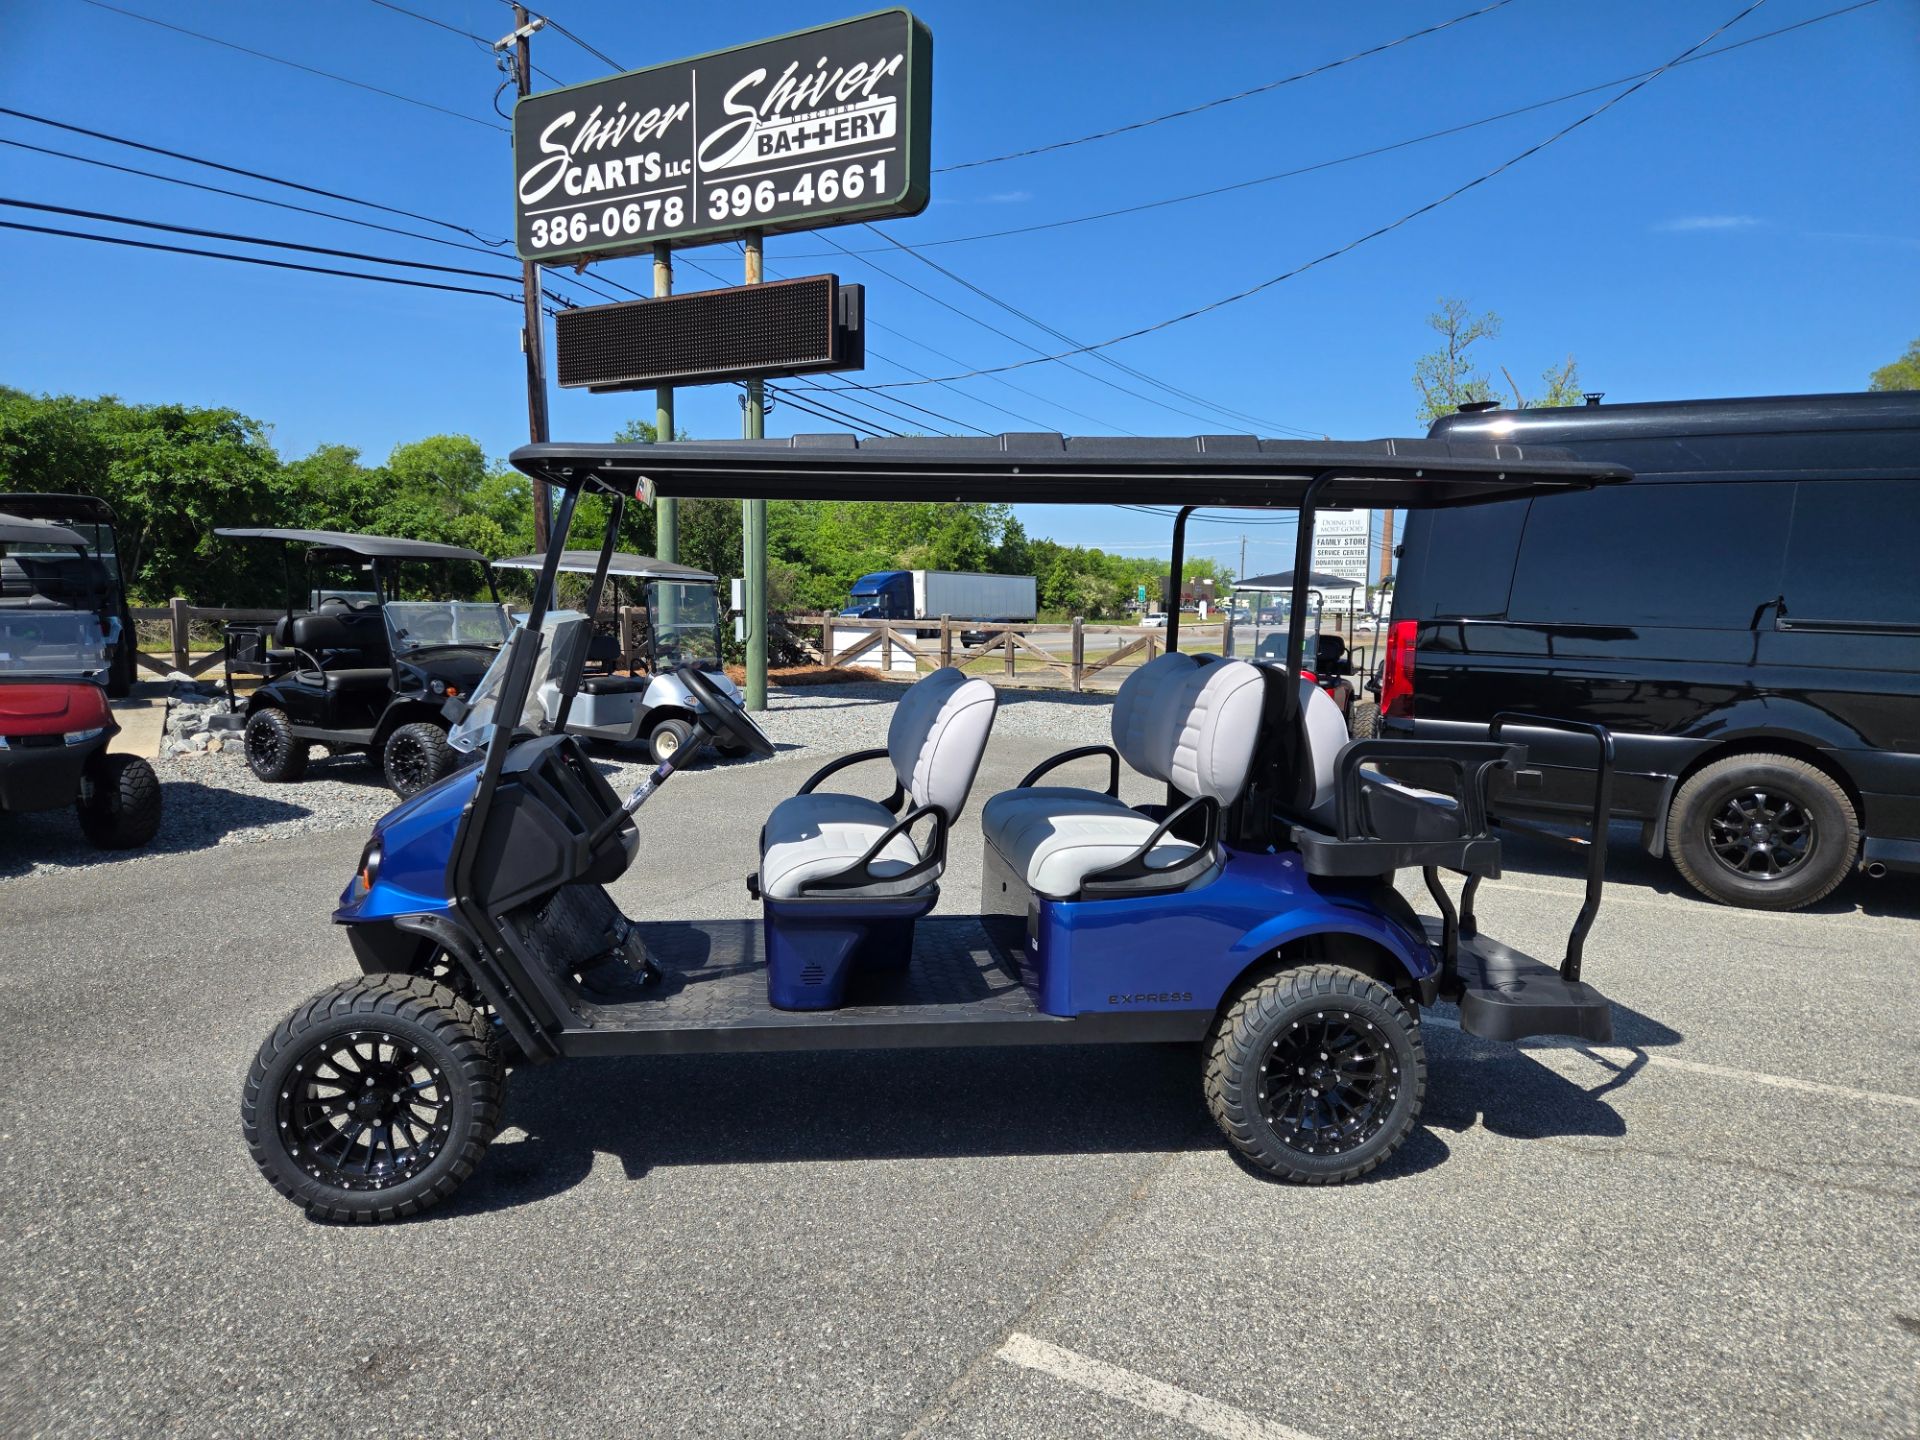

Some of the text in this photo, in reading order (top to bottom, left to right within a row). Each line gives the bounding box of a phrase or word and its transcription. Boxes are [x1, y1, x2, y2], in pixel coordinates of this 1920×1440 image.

[698, 54, 904, 172] Shiver
[791, 103, 858, 124] DISCOUNT
[519, 101, 690, 205] Shiver
[564, 152, 691, 196] CARTS LLC
[708, 159, 886, 220] 396-4661
[531, 196, 684, 248] 386-0678
[1316, 538, 1366, 546] FAMILY STORE
[1108, 992, 1193, 1004] EXPRESS
